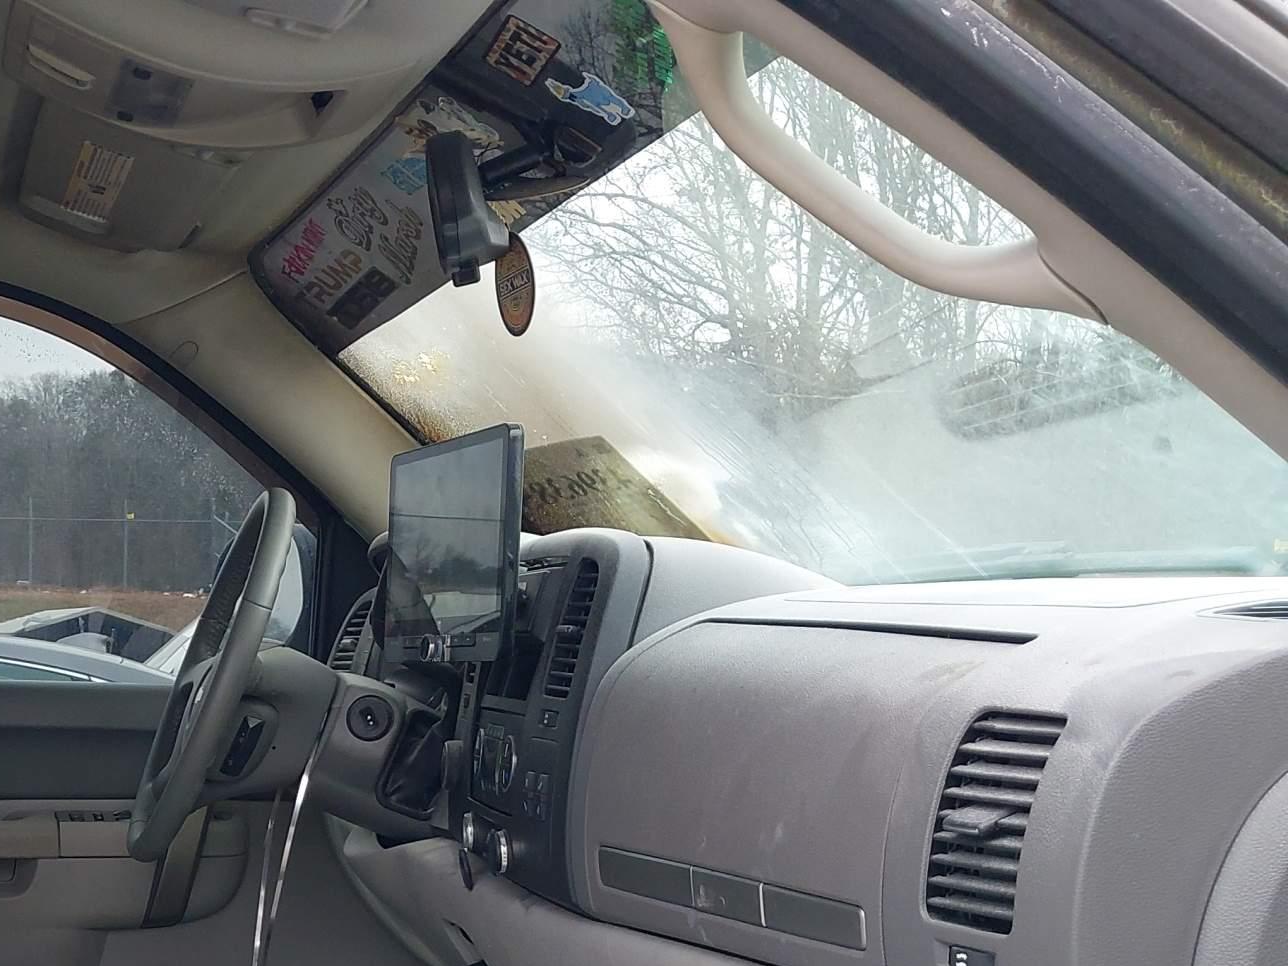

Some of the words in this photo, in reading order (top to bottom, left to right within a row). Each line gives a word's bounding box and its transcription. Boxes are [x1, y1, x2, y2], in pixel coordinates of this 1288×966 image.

[494, 25, 548, 77] YETI
[294, 248, 364, 311] TRUMP
[499, 279, 514, 296] SEX
[512, 269, 529, 291] WAX
